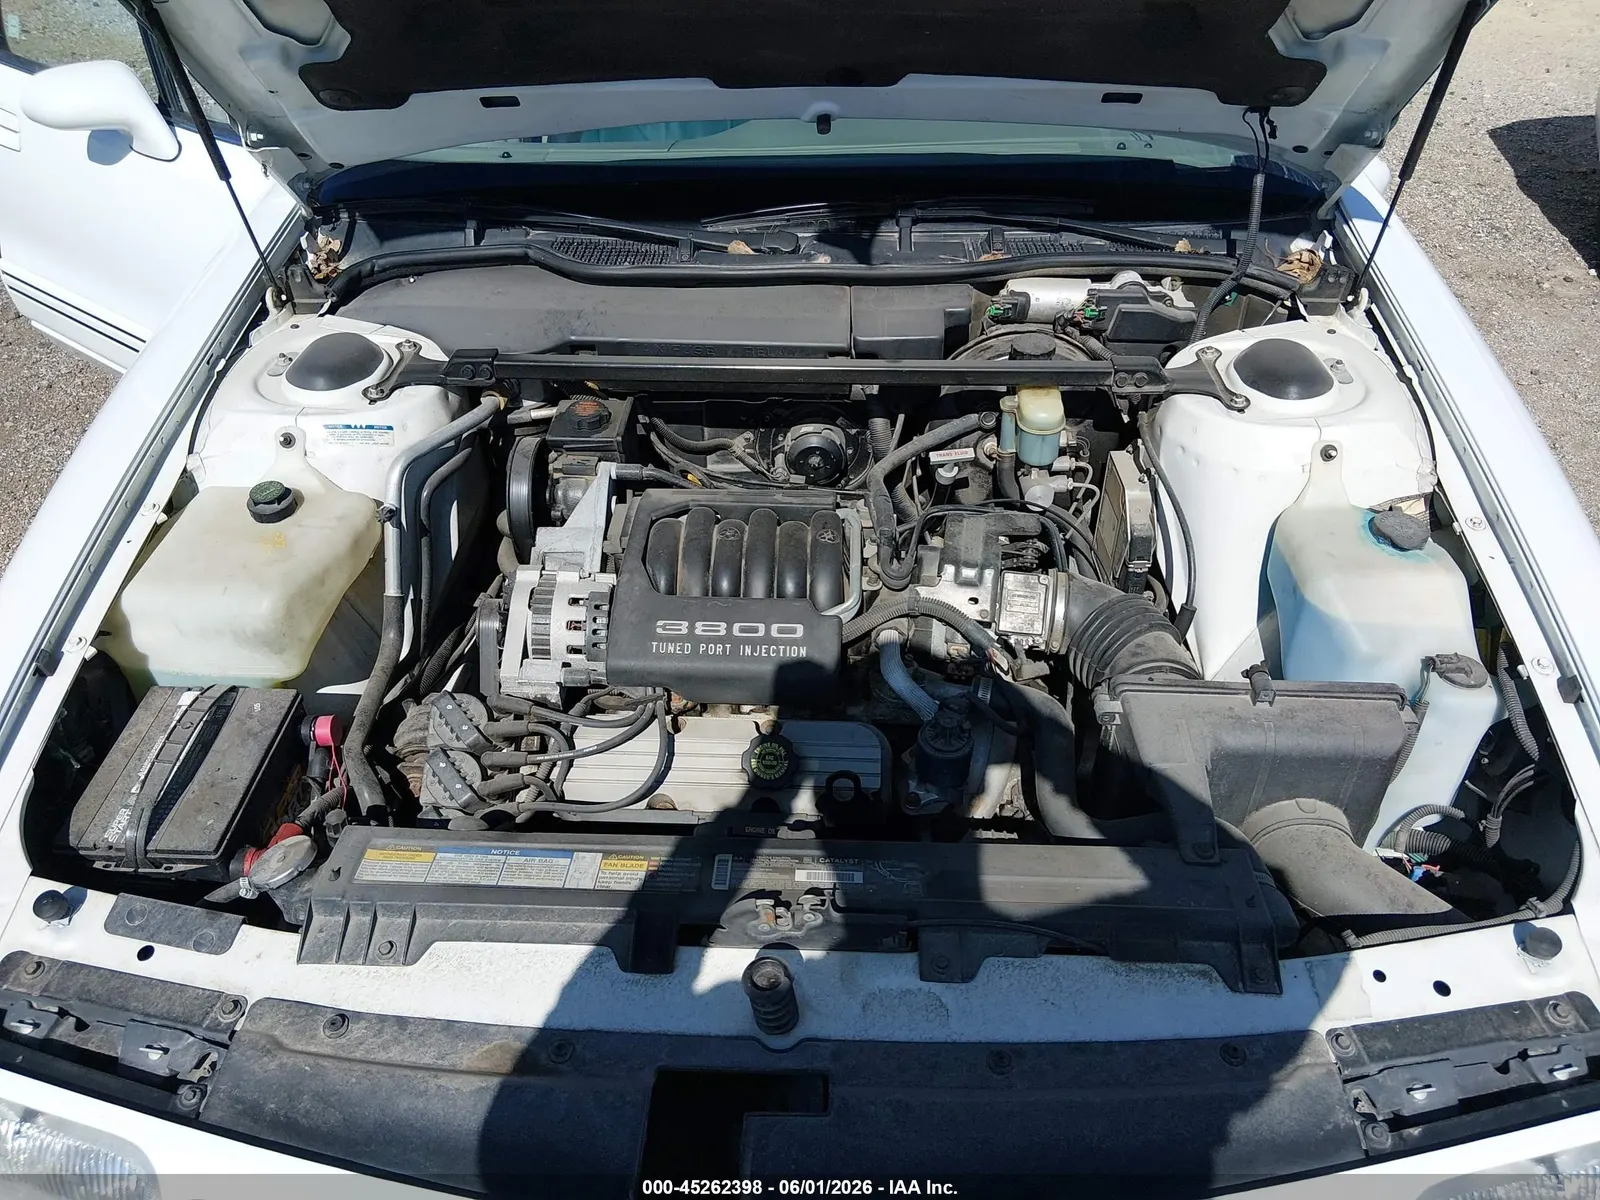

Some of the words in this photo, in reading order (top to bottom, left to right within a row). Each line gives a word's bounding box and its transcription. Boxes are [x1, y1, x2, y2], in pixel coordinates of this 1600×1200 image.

[656, 620, 804, 639] 3800
[651, 641, 692, 655] TUNED
[699, 643, 732, 656] PORT
[739, 644, 807, 658] INJECTION
[104, 808, 129, 838] SUPER
[108, 807, 132, 843] START
